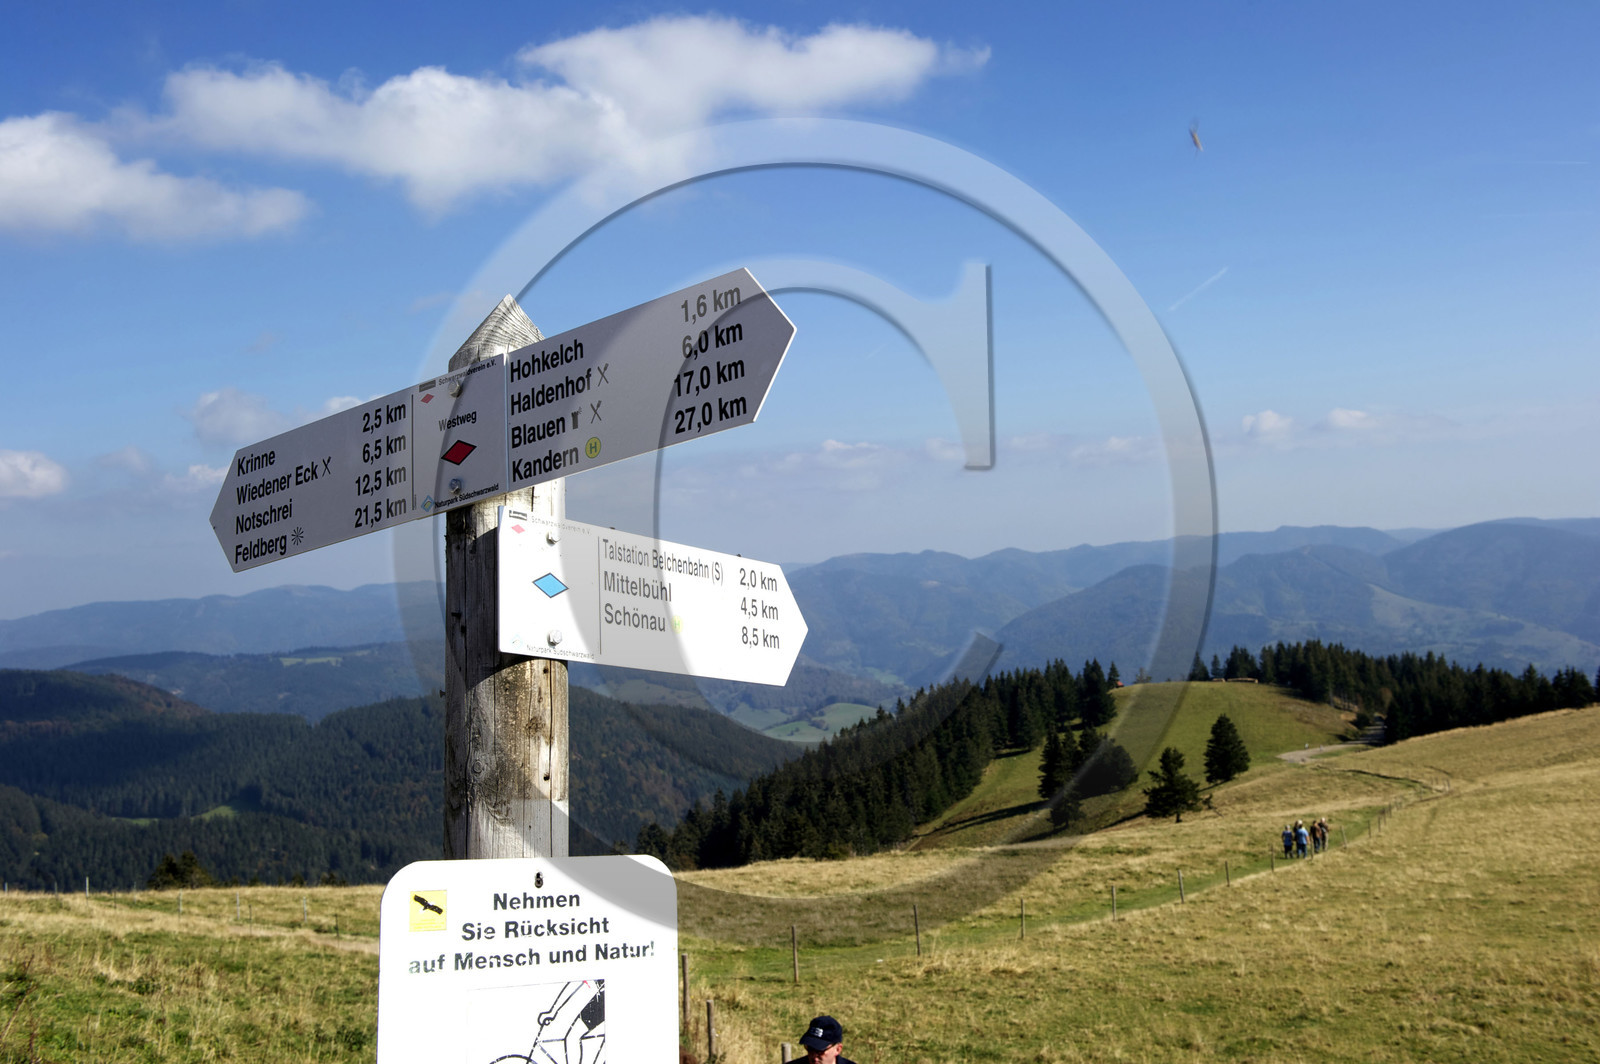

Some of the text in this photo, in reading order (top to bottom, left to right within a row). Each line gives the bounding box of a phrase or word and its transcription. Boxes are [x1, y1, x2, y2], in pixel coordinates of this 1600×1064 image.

[681, 286, 740, 324] 1,6 km
[682, 323, 742, 360] 6,0 km
[510, 339, 584, 383] Hohkelch
[510, 368, 592, 416] Haldenhof
[674, 360, 744, 397] 17,0 km
[363, 403, 406, 432] 2,5 km
[438, 411, 477, 431] Westweg
[674, 396, 747, 434] 27,0 km
[511, 416, 565, 449] Blauen
[237, 449, 276, 476] Krinne
[362, 434, 406, 464] 6,5 km
[512, 446, 578, 482] Kandern
[237, 462, 318, 505] Wiedener Eck
[356, 466, 406, 496] 12,5 km
[236, 498, 293, 535] Notschrei
[354, 504, 382, 529] 21,5
[386, 498, 406, 518] km
[235, 534, 287, 564] Feldberg
[603, 539, 724, 585] Talstation Belchenbahn (S)
[604, 570, 672, 602] Mittelbühl
[739, 568, 778, 592] 2,0 km
[604, 603, 665, 632] Schönau
[740, 597, 779, 621] 4,5 km
[742, 626, 780, 649] 8,5 km
[493, 892, 580, 911] Nehmen
[462, 922, 496, 941] Sie
[504, 917, 610, 938] Rücksicht
[409, 940, 655, 974] auf Mensch und Natur!
